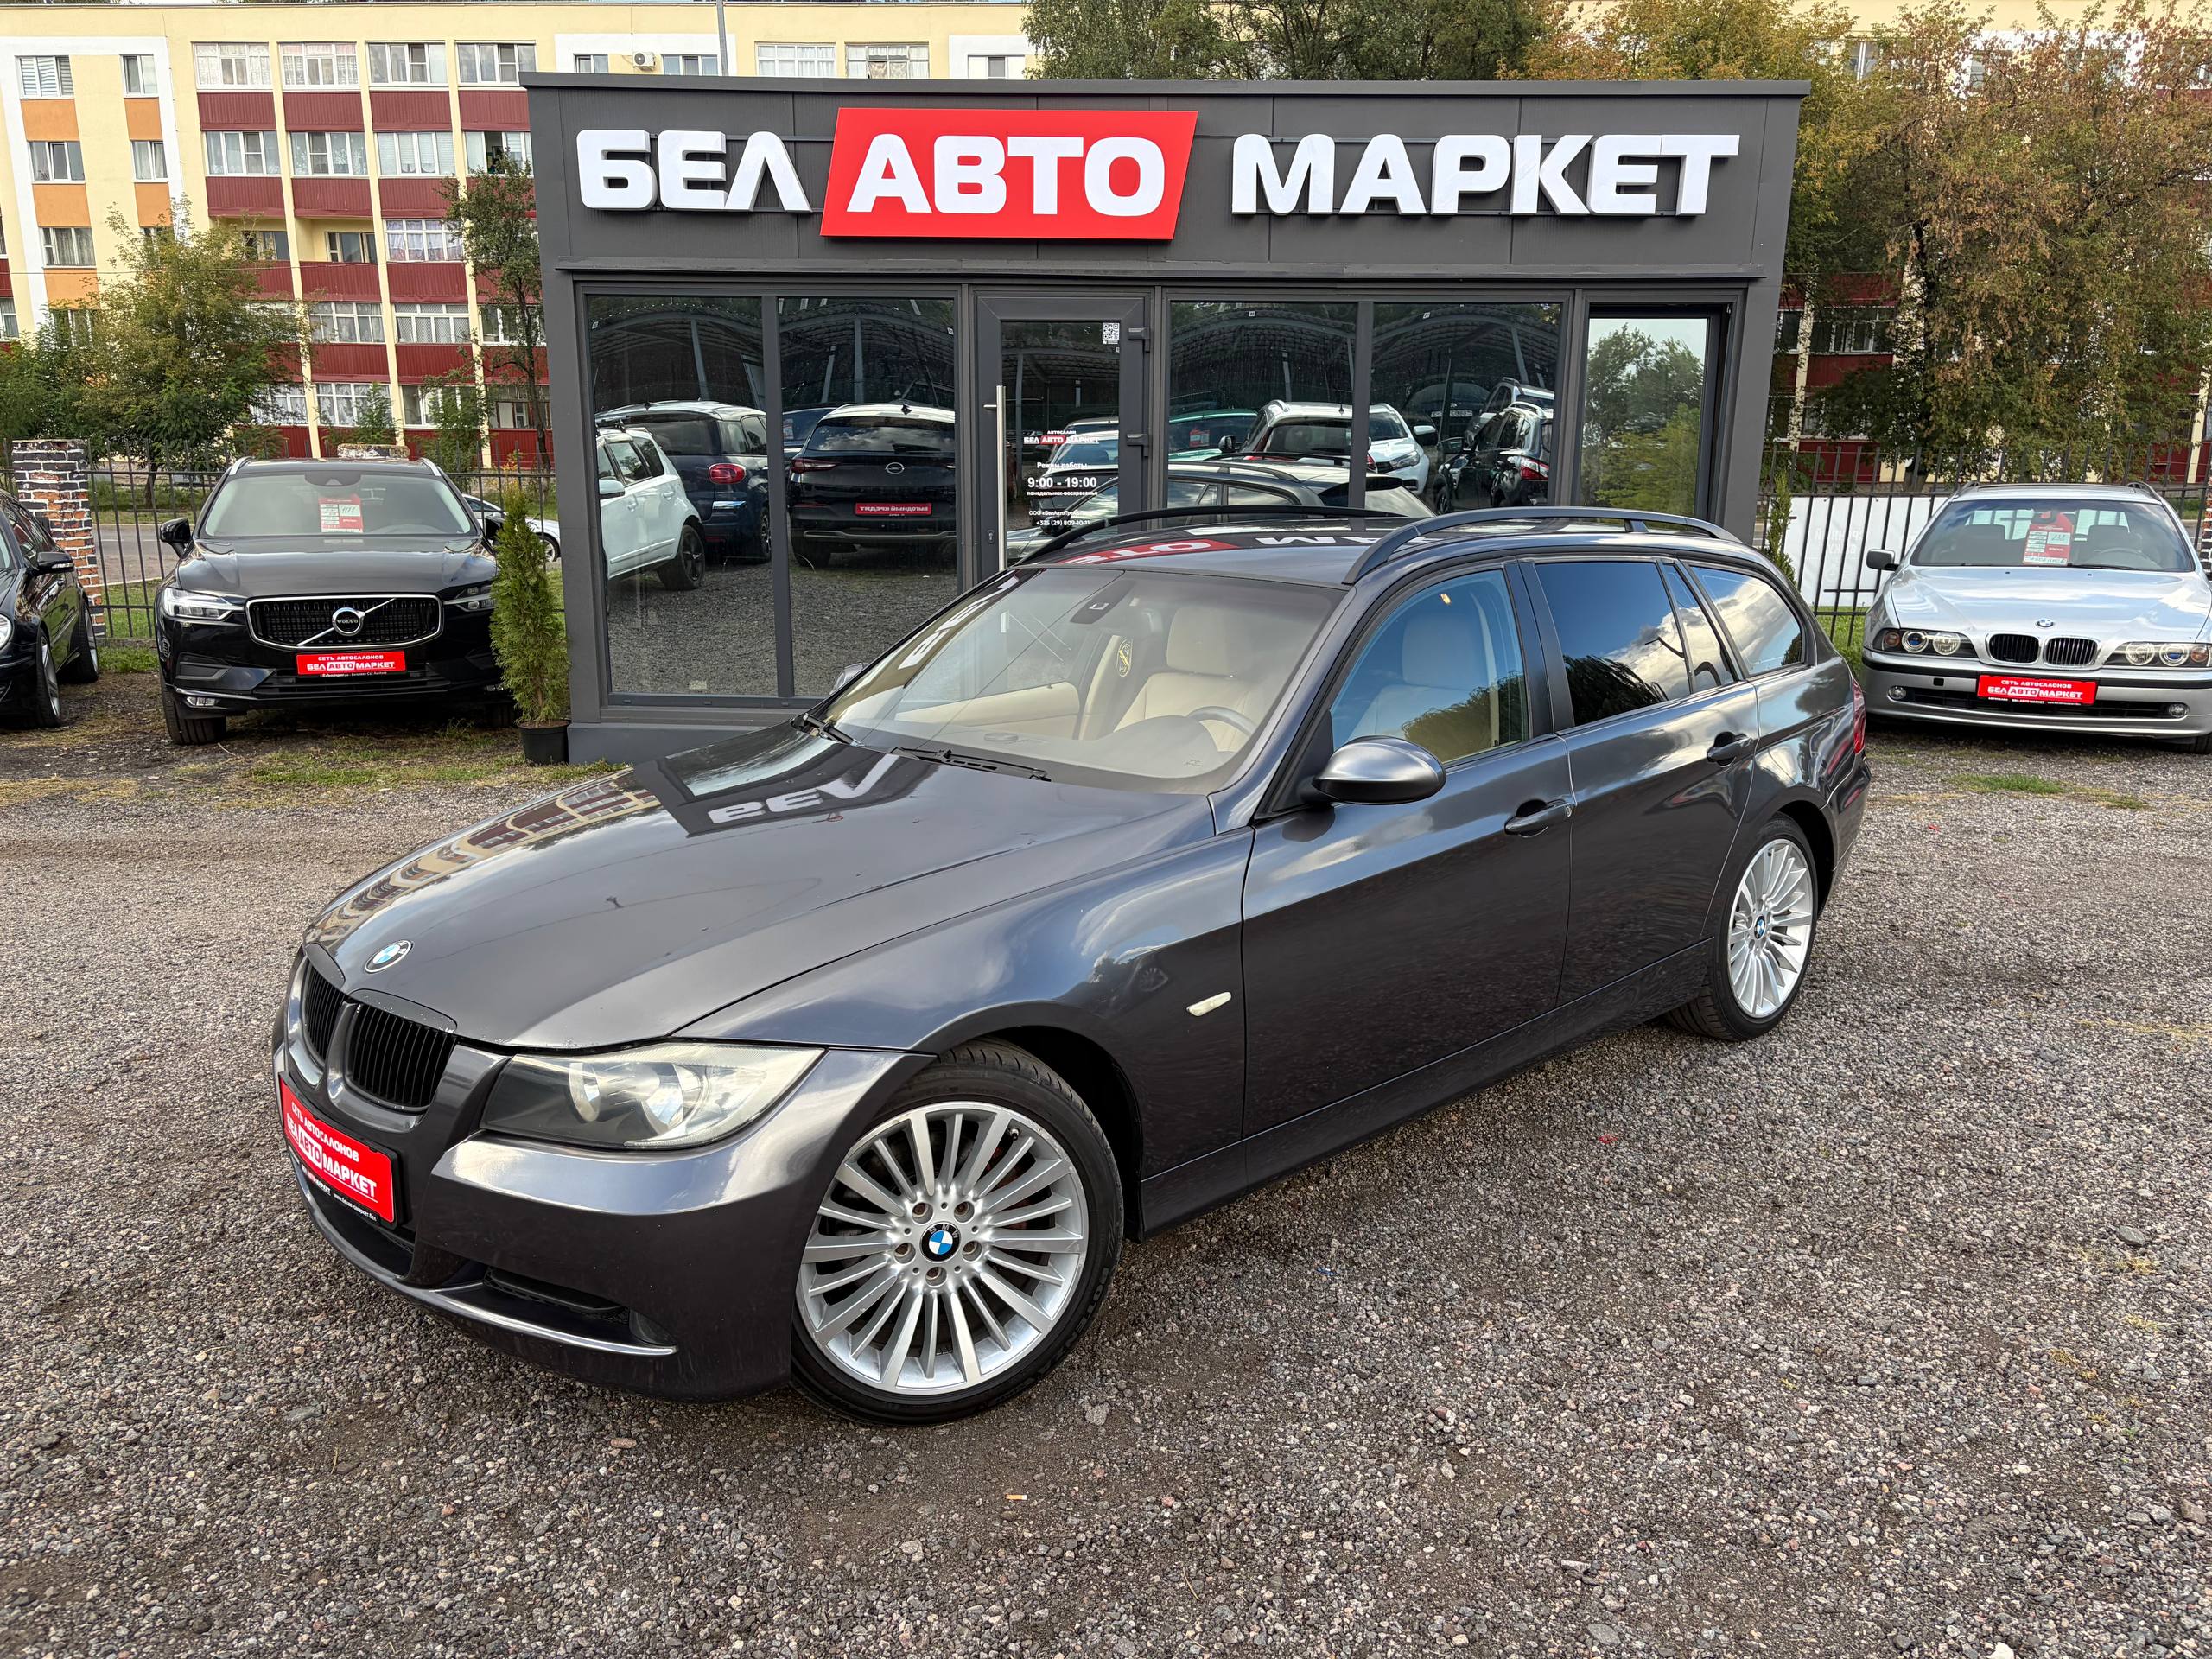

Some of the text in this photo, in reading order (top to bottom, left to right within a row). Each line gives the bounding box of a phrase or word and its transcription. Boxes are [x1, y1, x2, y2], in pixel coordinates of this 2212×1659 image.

[577, 130, 1739, 216] БЕЛ АВТО МАРКЕТ
[1027, 477, 1053, 487] 9:00
[1065, 477, 1097, 487] 19:00
[287, 1113, 299, 1141] БЕЛ
[299, 1128, 322, 1163] АВТО
[322, 1154, 378, 1198] МАРКЕТ
[291, 1102, 303, 1122] СЕТЬ
[304, 1117, 359, 1162] АВТОСАЛОНОВ
